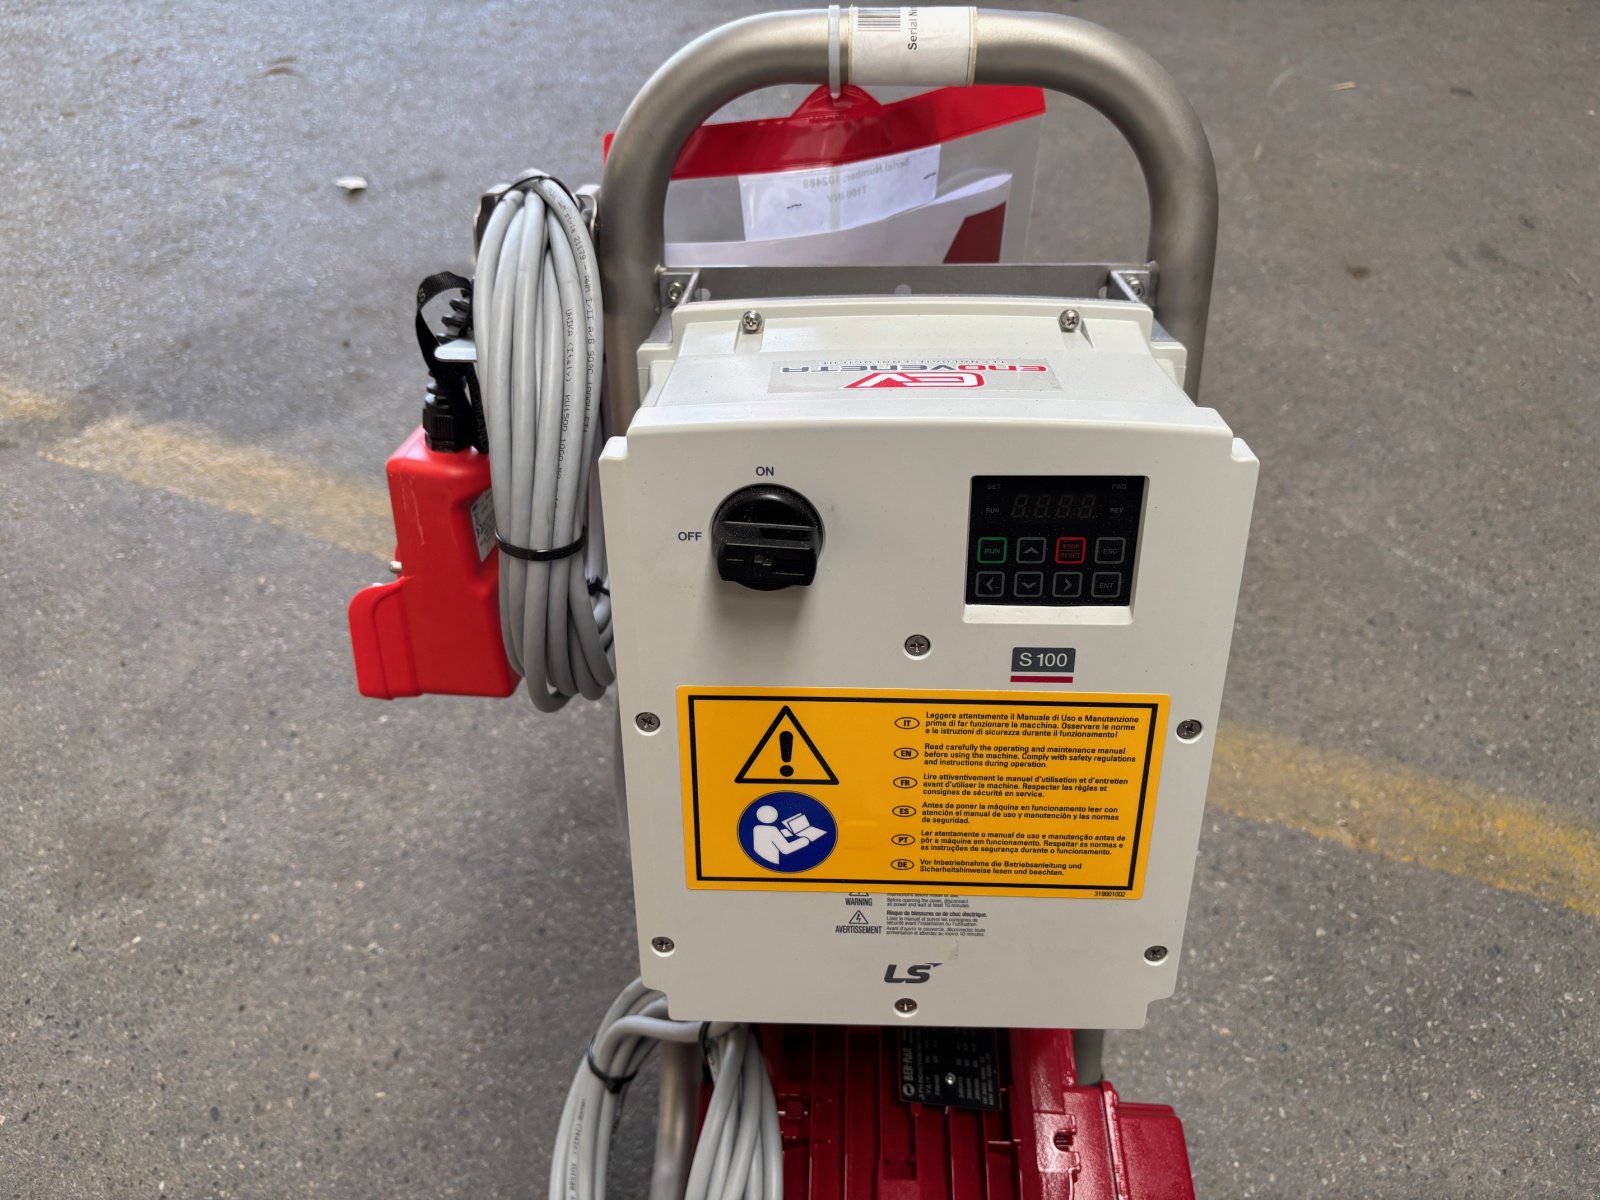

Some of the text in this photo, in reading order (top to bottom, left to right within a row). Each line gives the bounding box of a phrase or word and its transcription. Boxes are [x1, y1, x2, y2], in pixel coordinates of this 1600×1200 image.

[907, 18, 917, 50] Serial
[755, 466, 775, 476] ON
[678, 532, 702, 541] OFF
[1019, 653, 1068, 667] S 100
[926, 712, 956, 720] Leggere
[994, 745, 1029, 753] operating
[1093, 755, 1136, 763] regulations
[1010, 760, 1047, 768] operation.
[1004, 861, 1067, 870] Betriebsanleitung
[845, 898, 873, 906] WARNING
[835, 926, 882, 934] AVERTISSEMENT
[884, 963, 942, 984] LS
